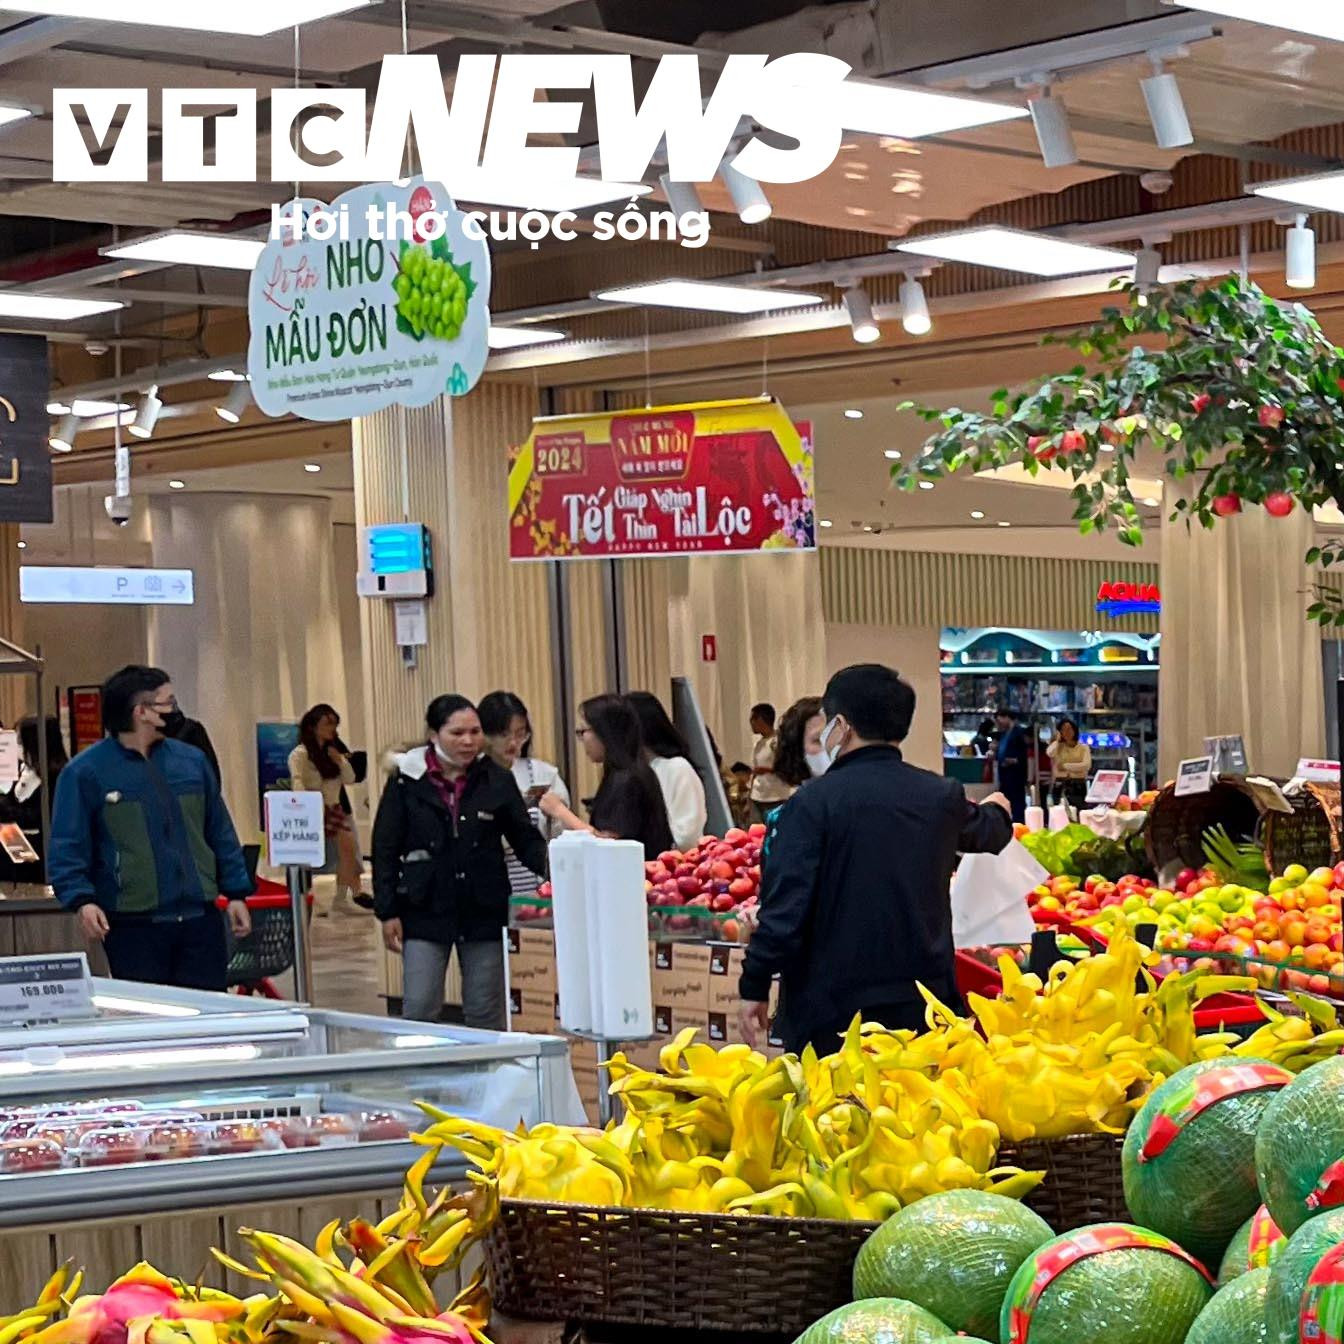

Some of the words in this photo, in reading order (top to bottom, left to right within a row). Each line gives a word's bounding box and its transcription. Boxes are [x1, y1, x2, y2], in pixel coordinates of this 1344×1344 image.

[327, 237, 385, 290] NHO
[266, 297, 320, 370] MẪU
[326, 297, 387, 358] ĐƠN
[537, 448, 583, 473] 2024
[562, 486, 615, 545] Tết
[613, 486, 648, 514] Giáp
[697, 485, 752, 546] Lộc
